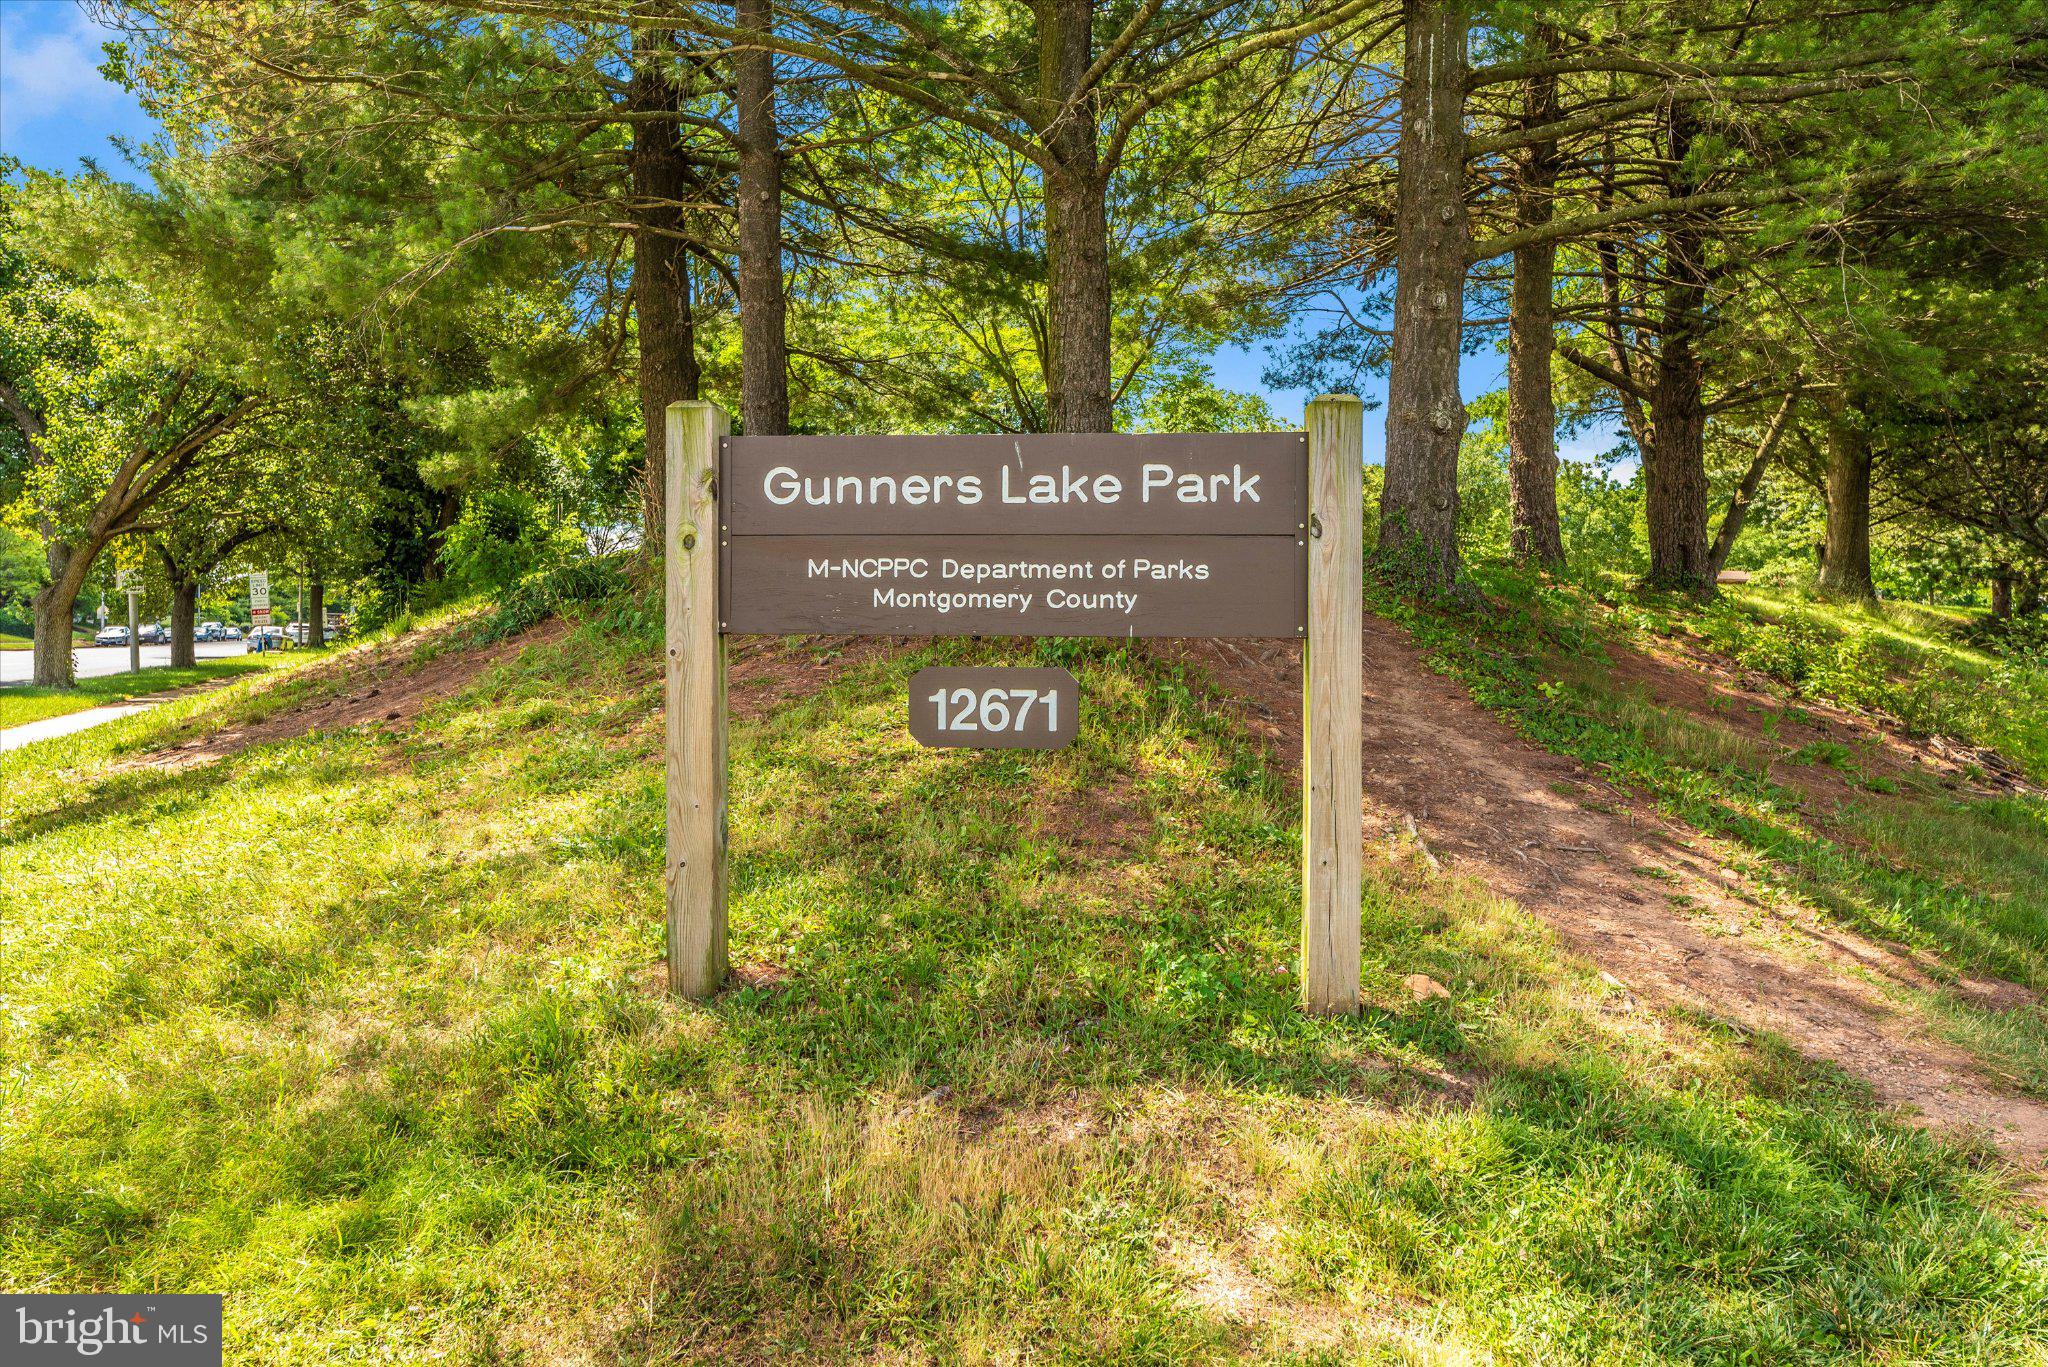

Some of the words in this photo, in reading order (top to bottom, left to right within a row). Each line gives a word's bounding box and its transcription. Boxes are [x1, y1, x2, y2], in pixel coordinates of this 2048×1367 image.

[763, 466, 983, 505] Gunners
[1001, 464, 1122, 504] Lake
[1142, 463, 1261, 503] Park
[807, 557, 929, 579] M-NCPPC
[942, 558, 1094, 584] Department
[1101, 558, 1126, 579] of
[1133, 558, 1210, 580] Parks
[252, 587, 267, 596] 30
[873, 588, 1033, 613] Montgomery
[1046, 588, 1138, 614] County
[928, 687, 1058, 732] 12671
